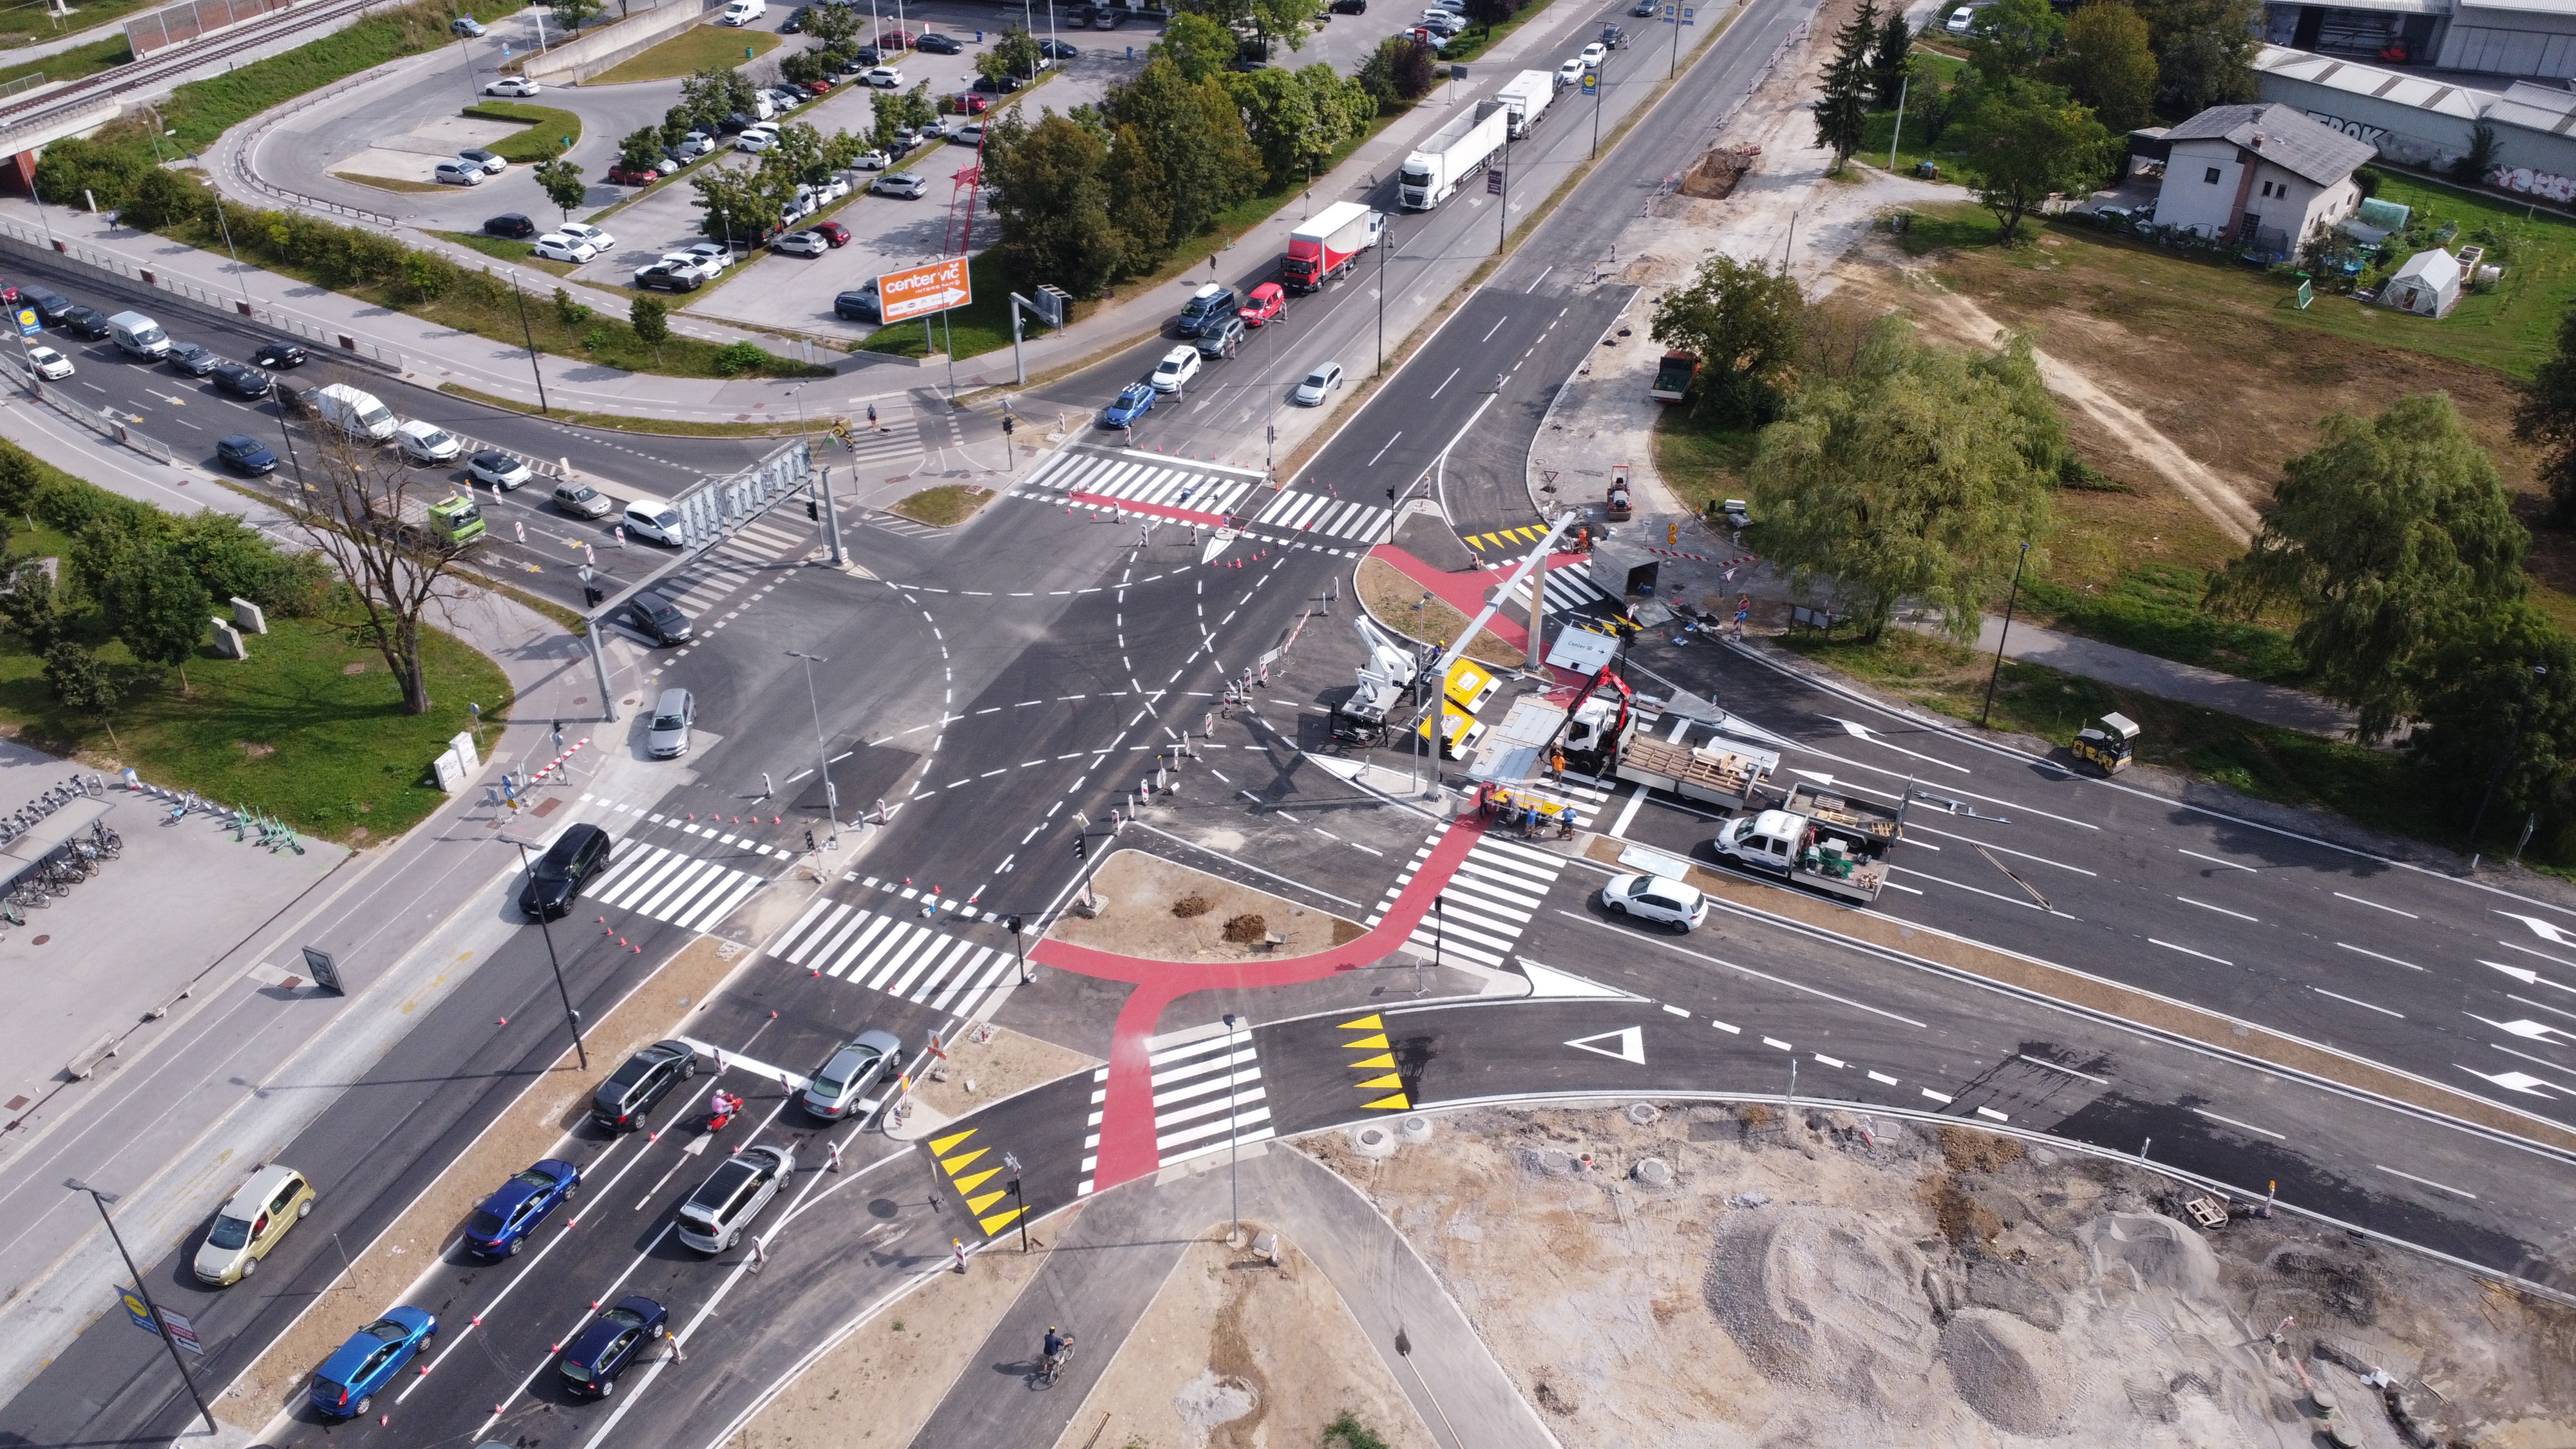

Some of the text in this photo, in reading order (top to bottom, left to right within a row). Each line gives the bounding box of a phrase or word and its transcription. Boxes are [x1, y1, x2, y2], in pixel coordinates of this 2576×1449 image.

[886, 262, 960, 294] center vič
[1567, 640, 1586, 649] Center
